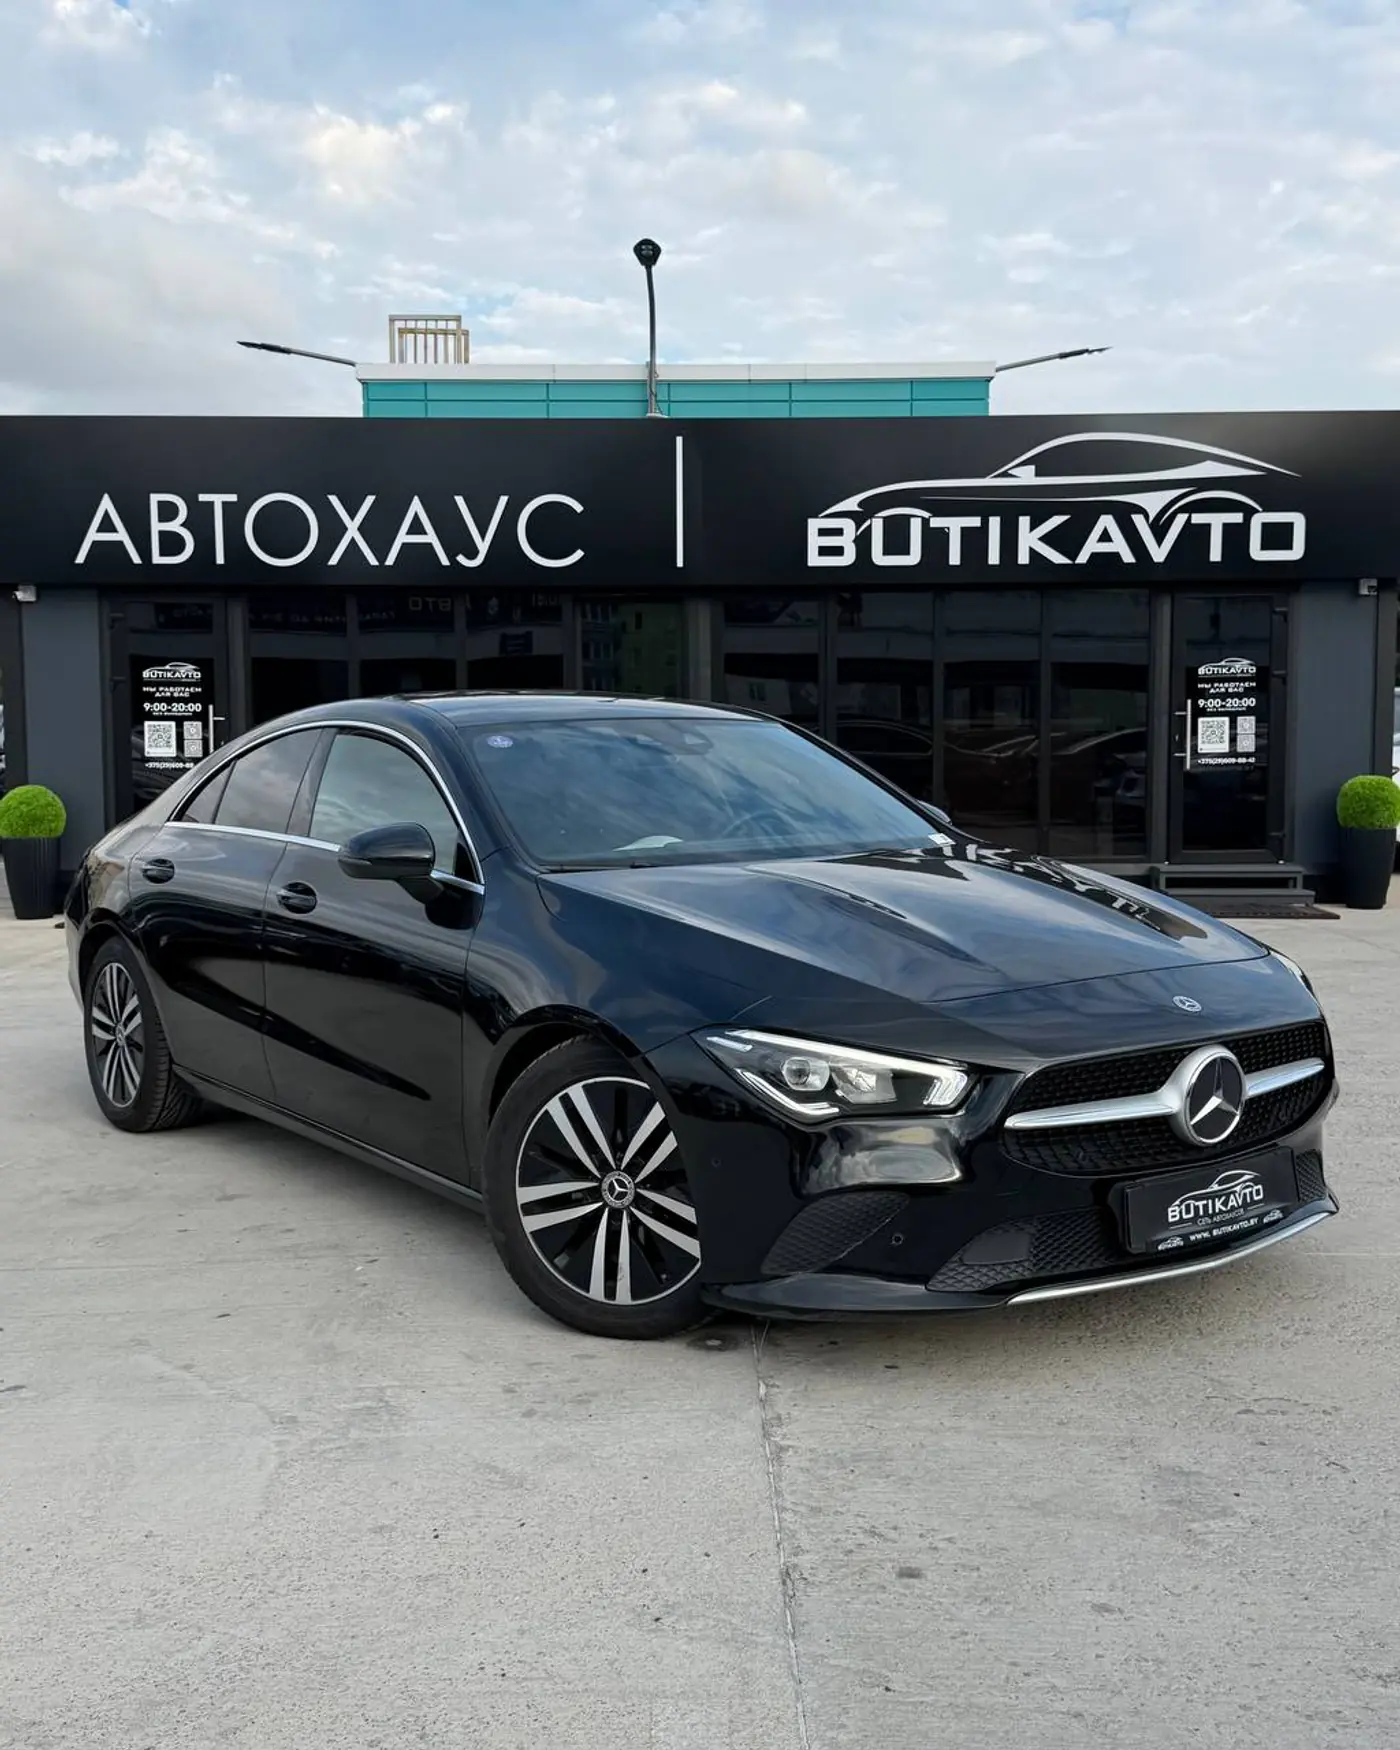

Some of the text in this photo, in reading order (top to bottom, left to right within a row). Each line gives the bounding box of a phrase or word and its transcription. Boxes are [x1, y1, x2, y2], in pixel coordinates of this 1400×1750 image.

[74, 492, 585, 568] АВТОХАУС
[807, 511, 1306, 567] BUTIKAVTO
[142, 671, 201, 679] BUTIKAVTO
[1197, 666, 1256, 675] BUTIKAVTO
[143, 702, 202, 713] 9:00-20:00
[1197, 697, 1256, 708] 9:00-20:00
[1167, 1184, 1264, 1222] BUTIKAVTO
